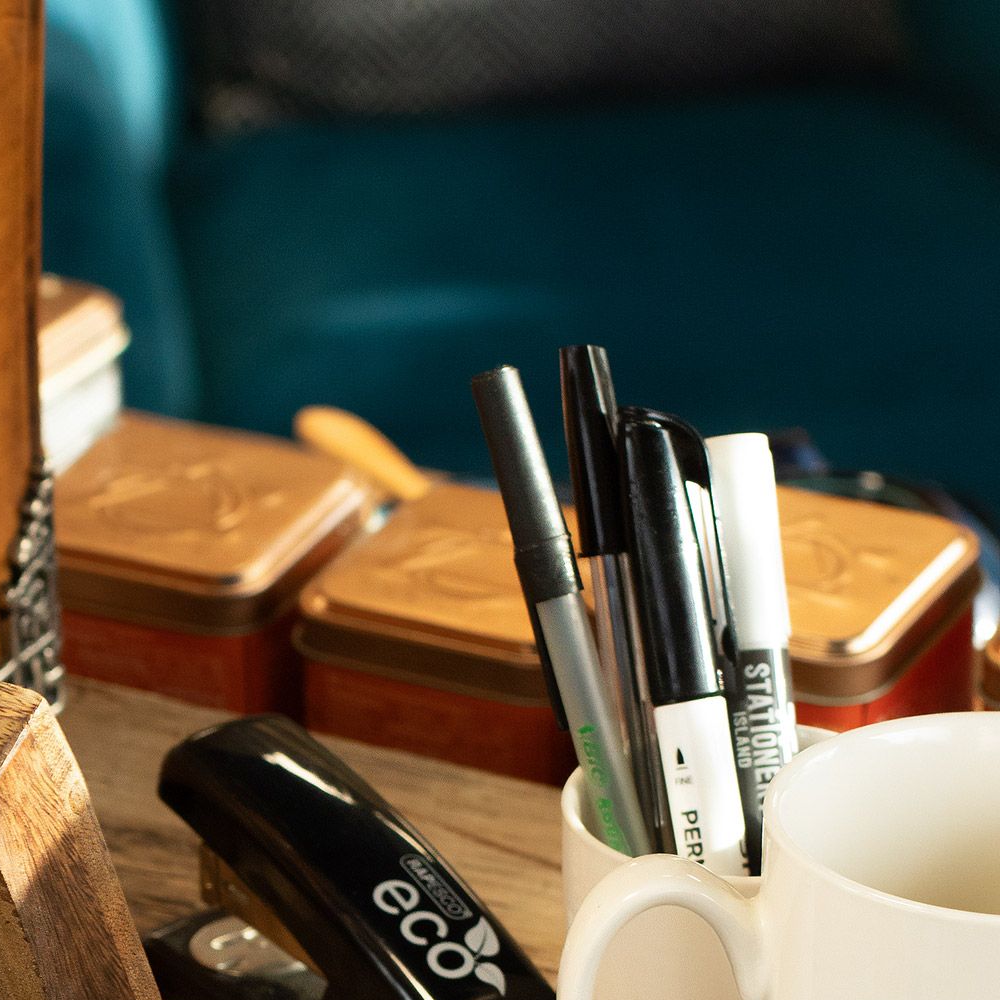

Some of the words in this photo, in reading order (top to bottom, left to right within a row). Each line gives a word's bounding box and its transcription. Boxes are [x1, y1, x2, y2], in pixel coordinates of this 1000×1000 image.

[733, 711, 753, 769] ISLAND
[744, 662, 781, 812] STATIONE
[681, 809, 705, 864] PER
[372, 879, 475, 979] eco
